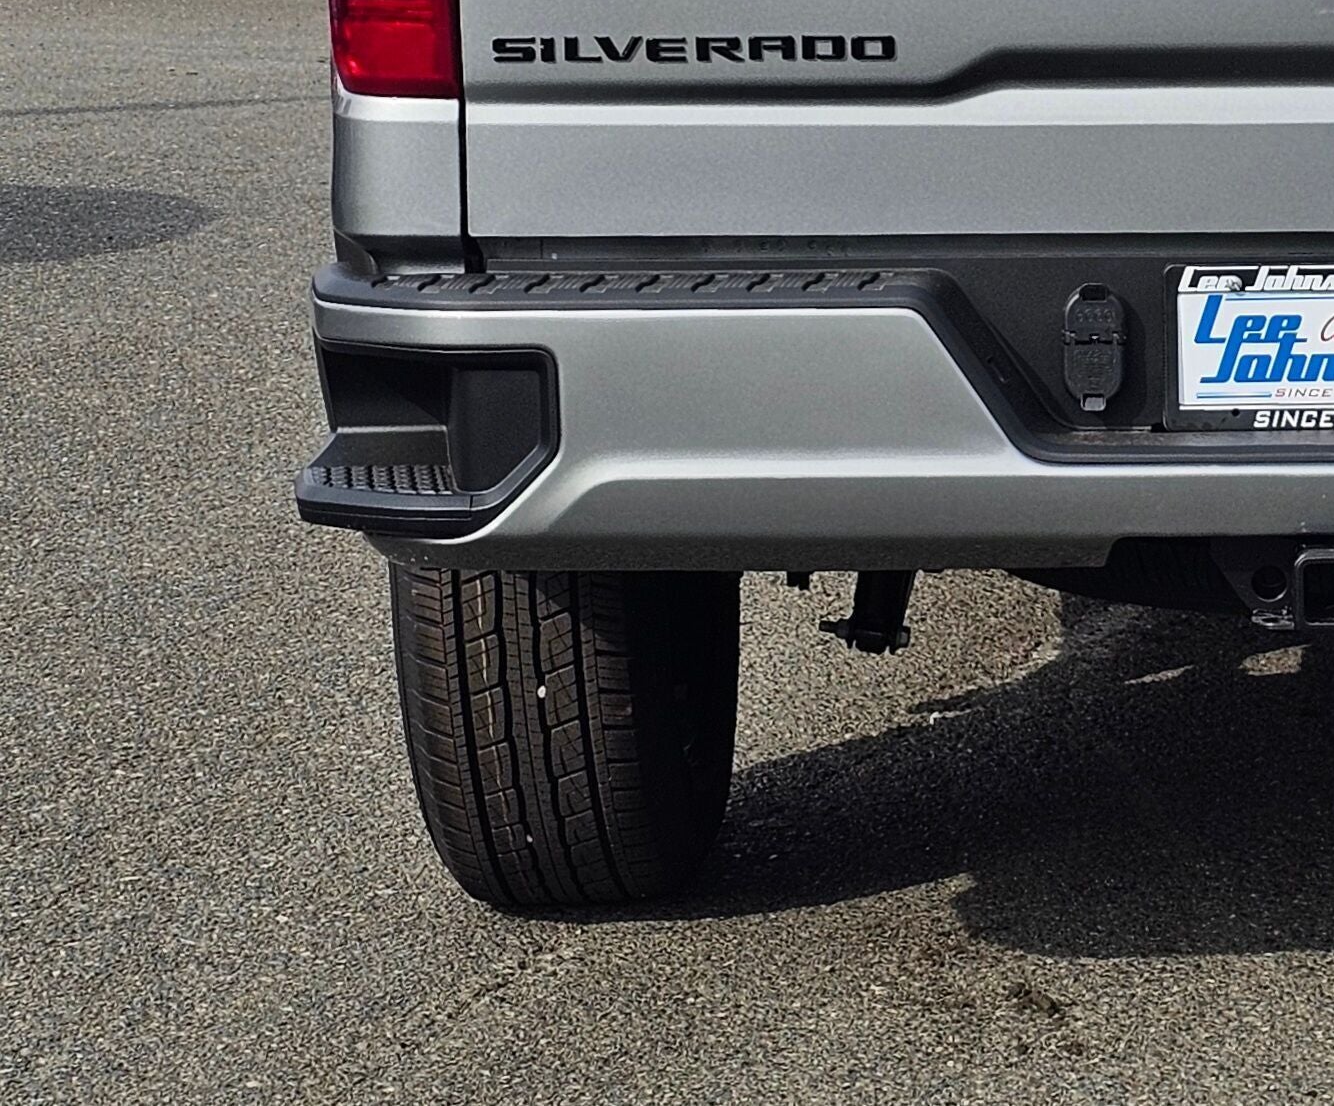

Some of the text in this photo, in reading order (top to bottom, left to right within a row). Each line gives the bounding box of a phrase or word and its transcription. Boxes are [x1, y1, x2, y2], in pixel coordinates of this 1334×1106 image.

[491, 35, 897, 63] SILVERADO
[1194, 294, 1307, 344] Lee
[1274, 387, 1333, 399] SINCE
